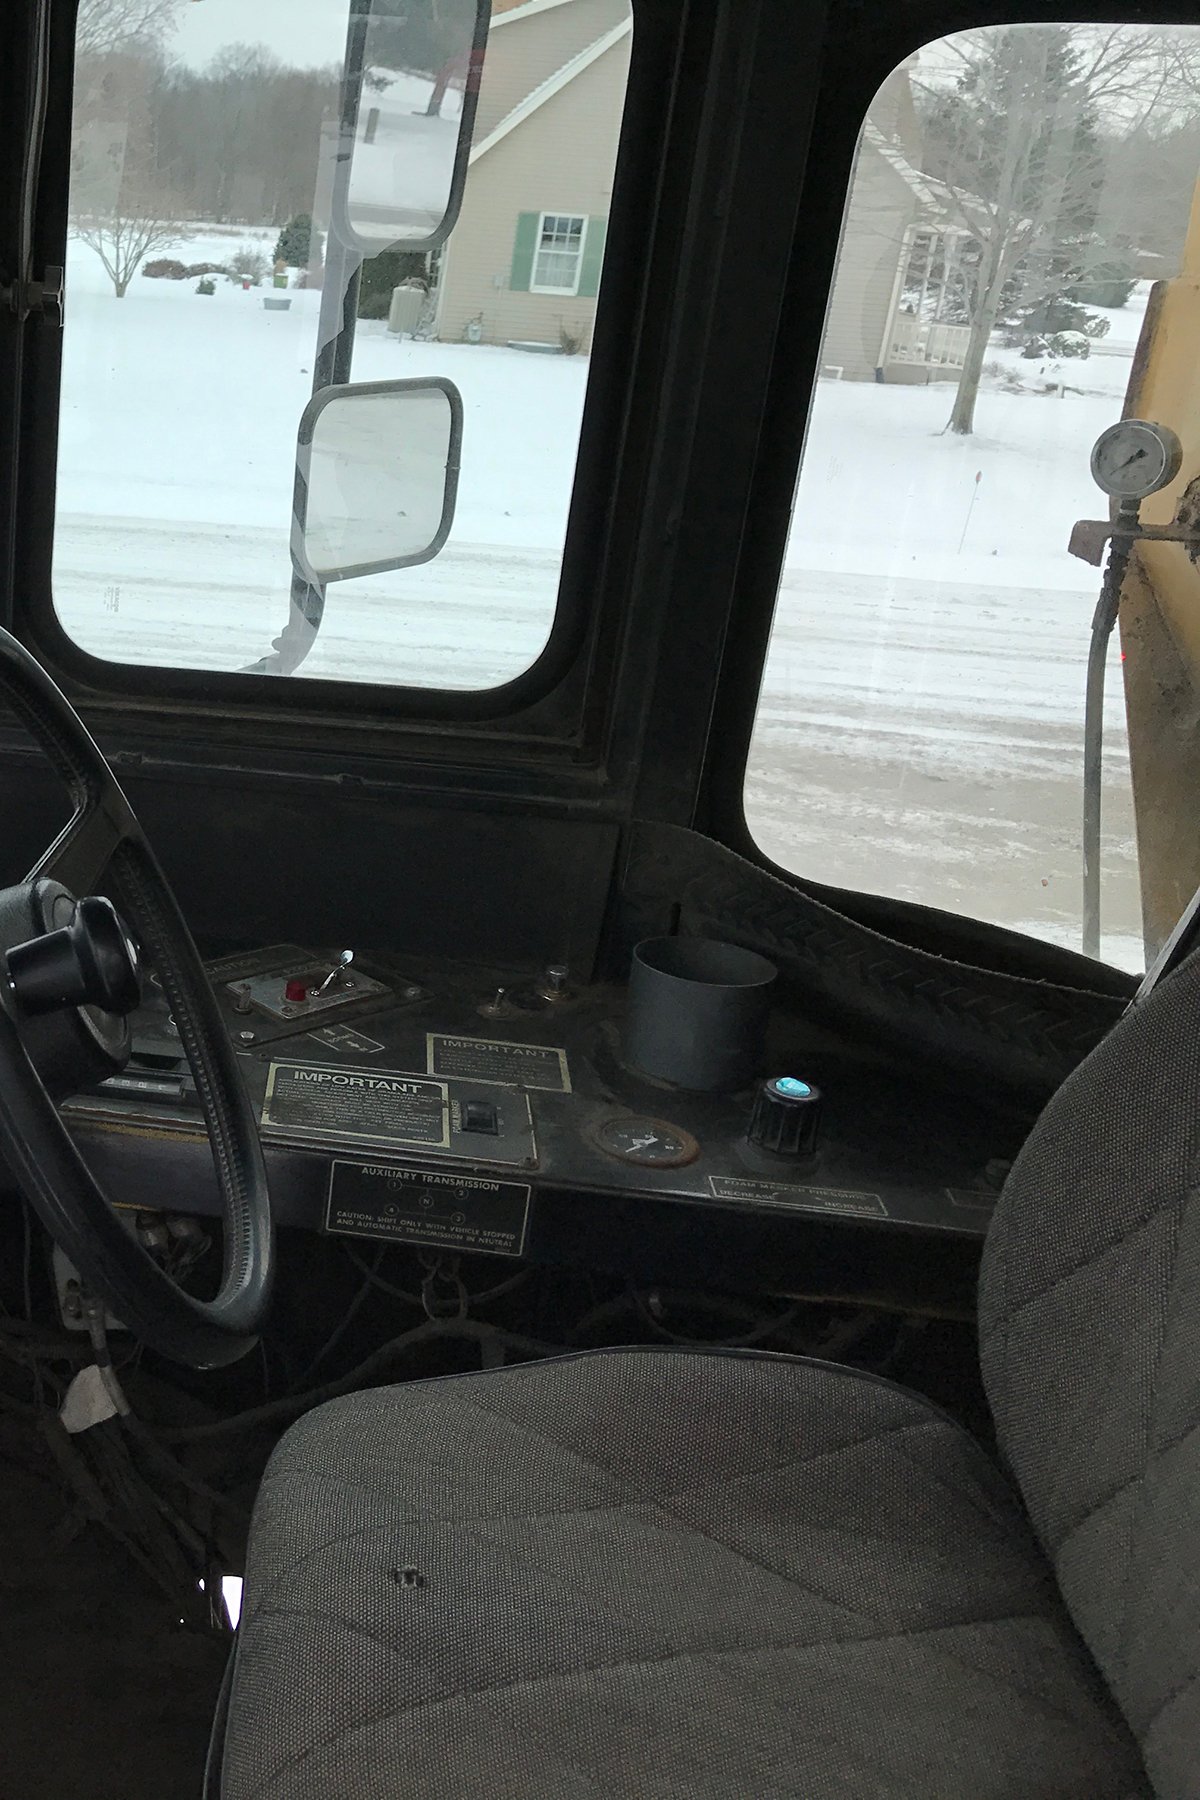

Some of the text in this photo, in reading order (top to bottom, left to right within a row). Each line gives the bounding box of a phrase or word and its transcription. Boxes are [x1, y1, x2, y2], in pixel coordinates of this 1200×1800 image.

[443, 1040, 549, 1058] IMPORTANT
[293, 1070, 422, 1094] IMPORTANT
[361, 1167, 500, 1191] AUXILIARY TRANSMISSION
[723, 1179, 756, 1187] FOAM
[336, 1218, 353, 1226] AND
[356, 1221, 401, 1232] AUTOMATIC
[405, 1227, 462, 1240] TRANSMISSION
[478, 1237, 512, 1247] NEUTRAL
[377, 1216, 396, 1224] SHIFT
[399, 1219, 421, 1227] ONLY
[449, 1226, 478, 1235] VEHICLE
[481, 1230, 515, 1240] STOPPED
